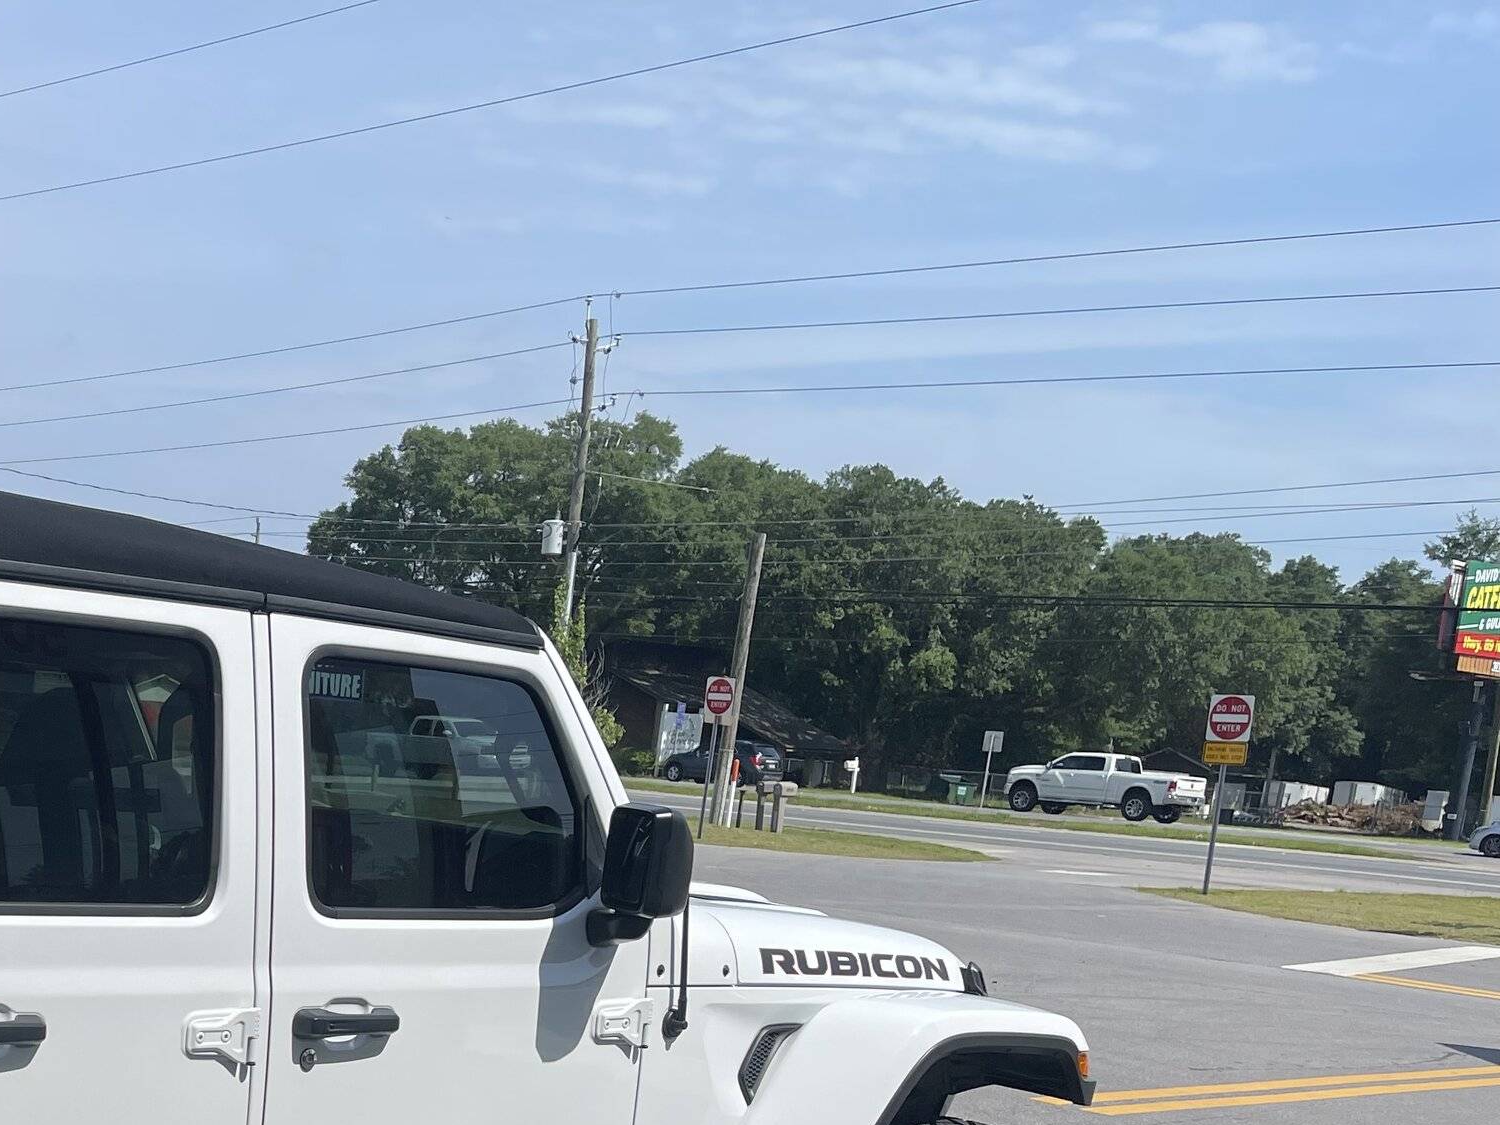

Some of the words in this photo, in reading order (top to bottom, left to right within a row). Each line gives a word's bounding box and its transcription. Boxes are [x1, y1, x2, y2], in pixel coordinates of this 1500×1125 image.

[1475, 568, 1500, 583] DAVID
[1486, 617, 1500, 630] GUL
[710, 700, 727, 708] ENTER
[1216, 704, 1227, 712] DO
[1231, 704, 1247, 713] NOT
[1216, 724, 1241, 732] ENTER
[759, 947, 950, 982] RUBICON
